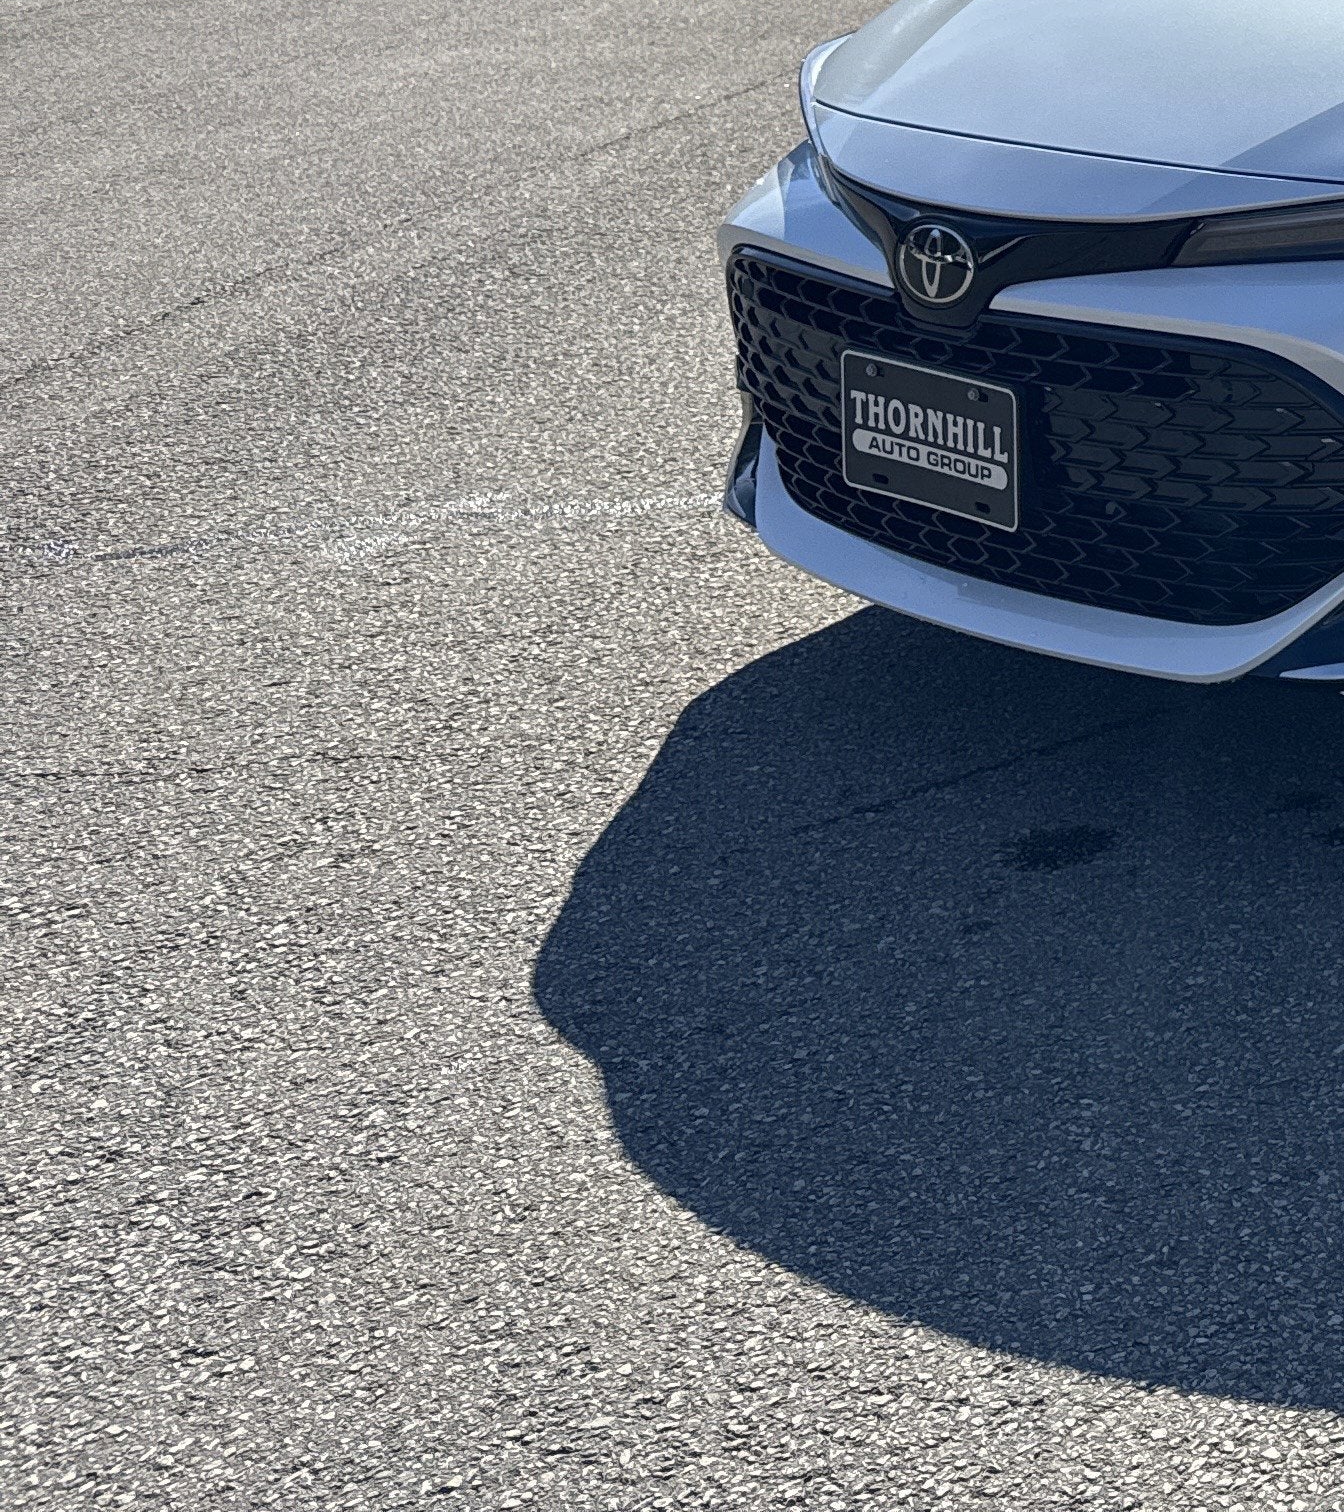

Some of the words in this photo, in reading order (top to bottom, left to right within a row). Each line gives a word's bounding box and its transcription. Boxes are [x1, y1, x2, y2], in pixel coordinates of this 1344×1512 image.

[850, 389, 1009, 464] THORNHILL
[868, 436, 920, 462] AUTO
[926, 450, 992, 481] GROUP
